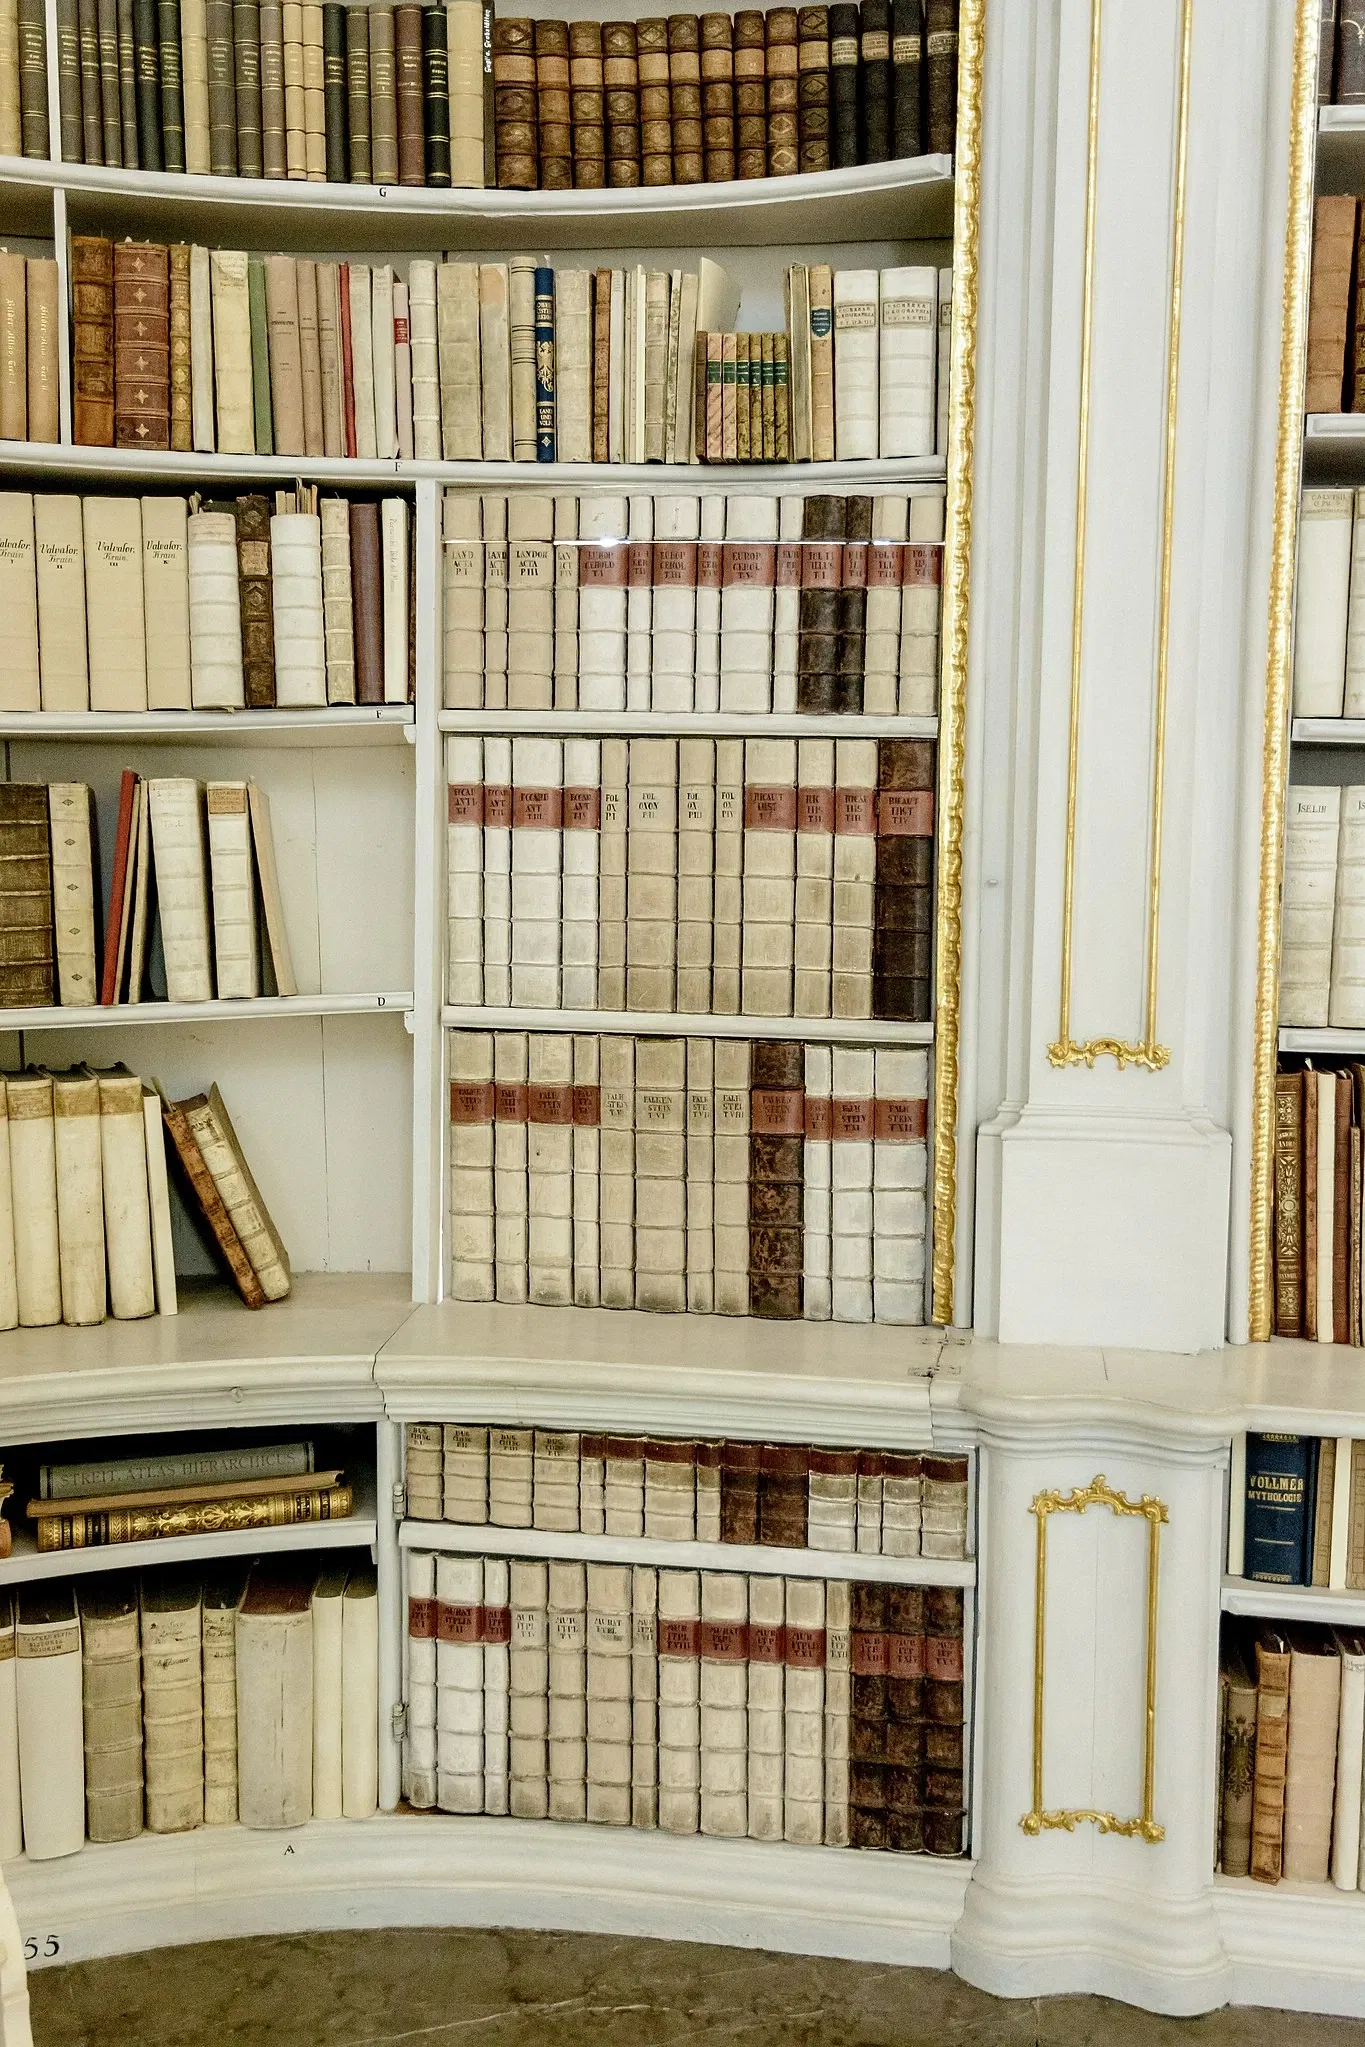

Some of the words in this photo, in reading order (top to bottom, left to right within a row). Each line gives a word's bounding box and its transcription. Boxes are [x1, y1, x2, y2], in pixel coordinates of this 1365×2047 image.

[379, 187, 387, 197] G
[395, 462, 403, 472] F
[376, 709, 383, 718] F
[377, 997, 386, 1006] D
[125, 1464, 176, 1482] ATLAS
[182, 1452, 297, 1477] HIERARCHICUS
[1250, 1475, 1304, 1490] VOLLMER
[1247, 1490, 1303, 1503] MYTHOLOGIE
[283, 1844, 296, 1856] A
